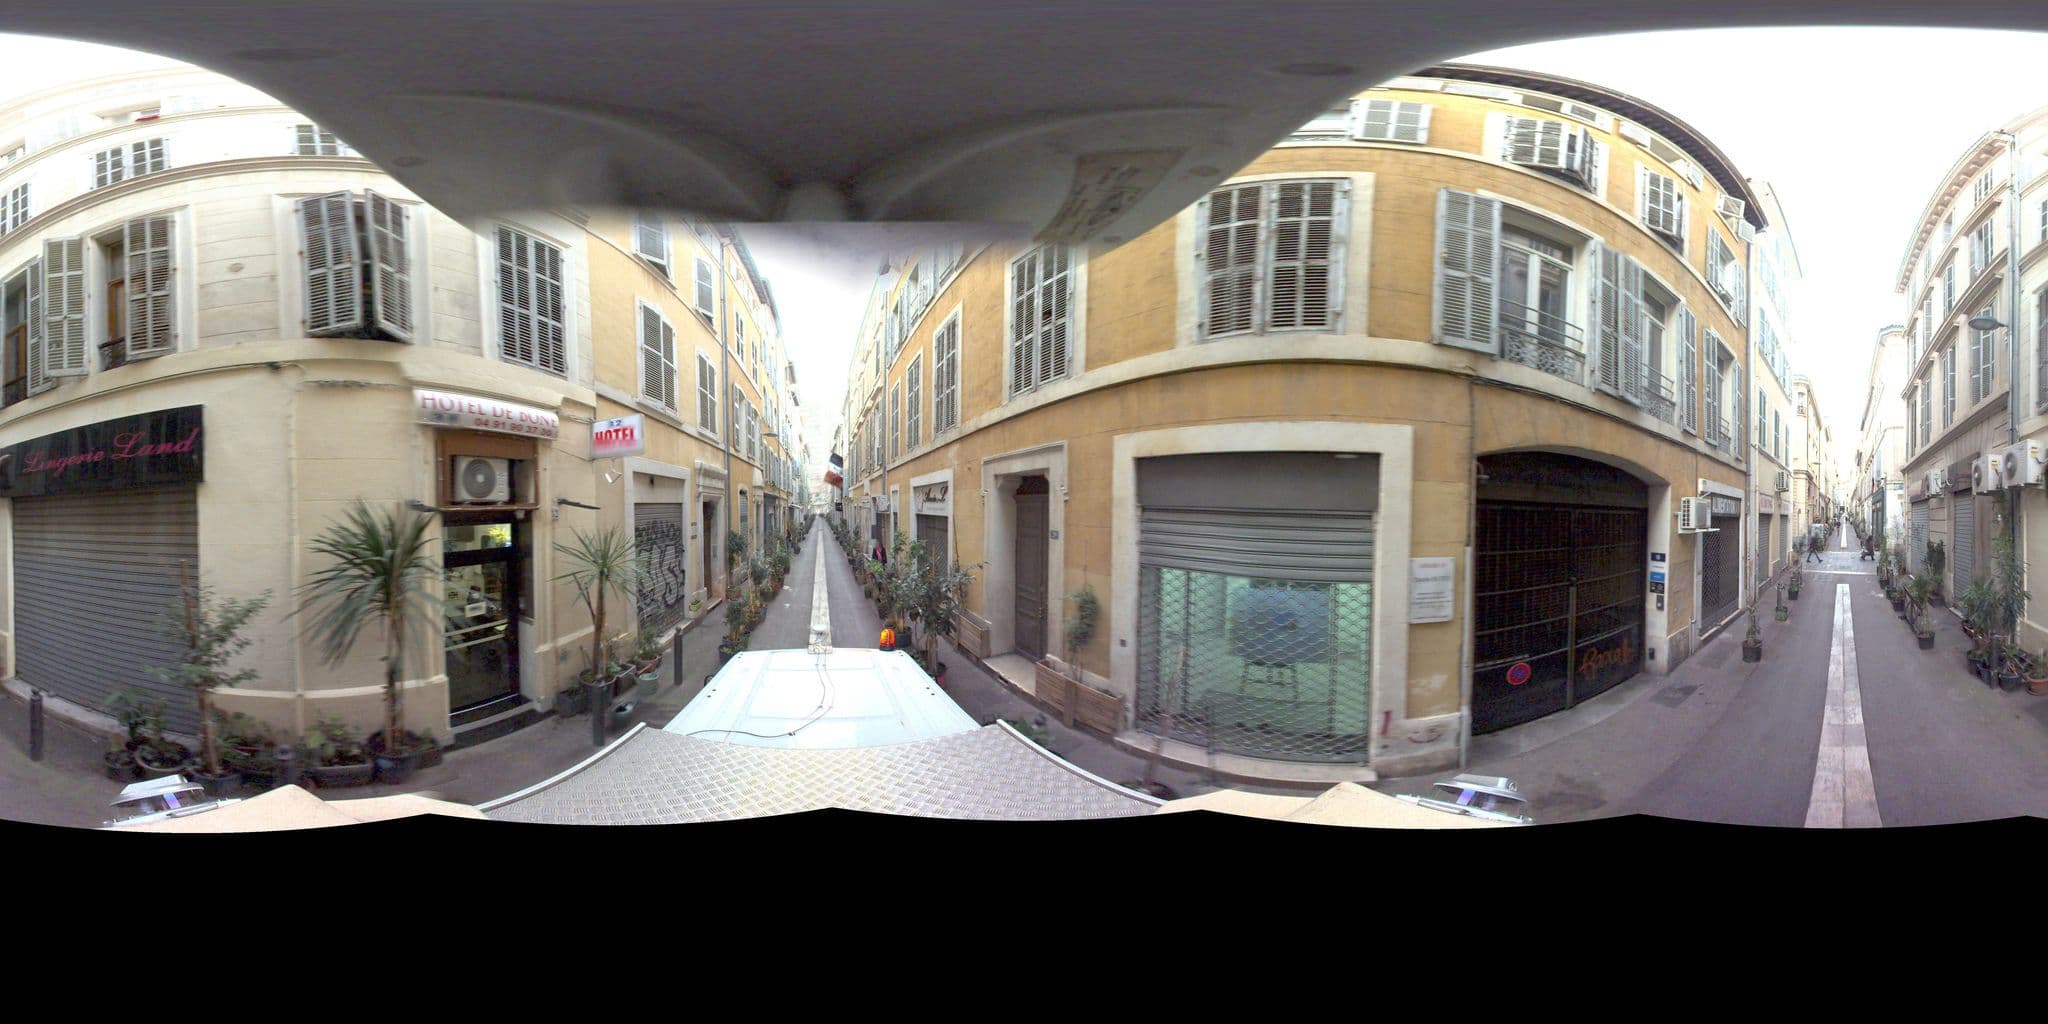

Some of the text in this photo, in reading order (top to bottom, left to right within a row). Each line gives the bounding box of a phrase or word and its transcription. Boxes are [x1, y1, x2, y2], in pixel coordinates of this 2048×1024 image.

[421, 391, 485, 416] HOTEL
[593, 425, 636, 447] HOTEL
[22, 426, 201, 478] Lingerie Land
